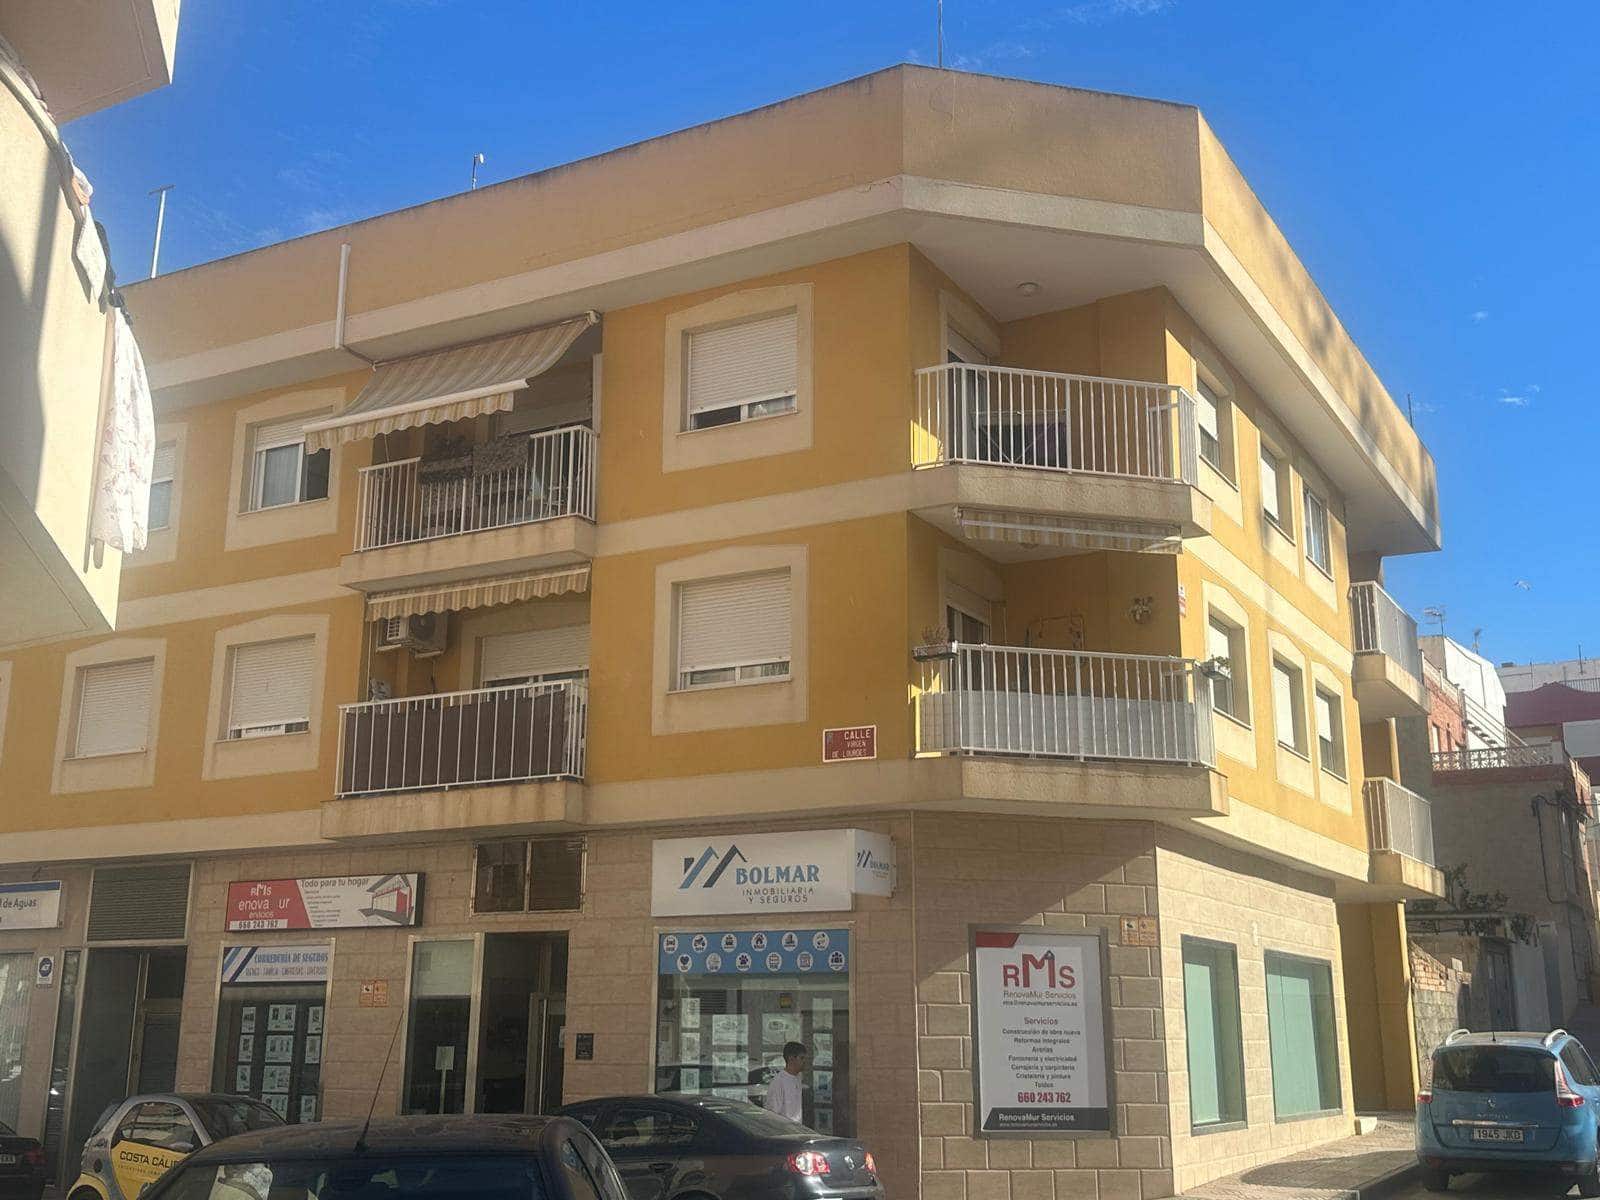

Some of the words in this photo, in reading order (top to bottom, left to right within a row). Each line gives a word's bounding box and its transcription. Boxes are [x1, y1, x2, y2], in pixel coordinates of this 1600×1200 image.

[844, 729, 871, 740] CALLE
[735, 864, 820, 885] BOLMAR
[301, 879, 318, 889] Todo
[320, 880, 337, 889] para
[338, 878, 347, 887] tu
[348, 877, 369, 888] hogar
[742, 886, 814, 897] INMOBILIARIA
[12, 897, 38, 911] Aguas
[759, 895, 808, 904] SEGUROS
[1002, 950, 1076, 989] RMS
[1024, 1016, 1058, 1026] Servicios
[1017, 1091, 1036, 1103] 660
[1037, 1091, 1054, 1103] 243
[1055, 1091, 1072, 1103] 762
[1041, 1113, 1075, 1121] Servicios
[1477, 1128, 1500, 1140] 1945
[120, 1150, 150, 1165] COSTA
